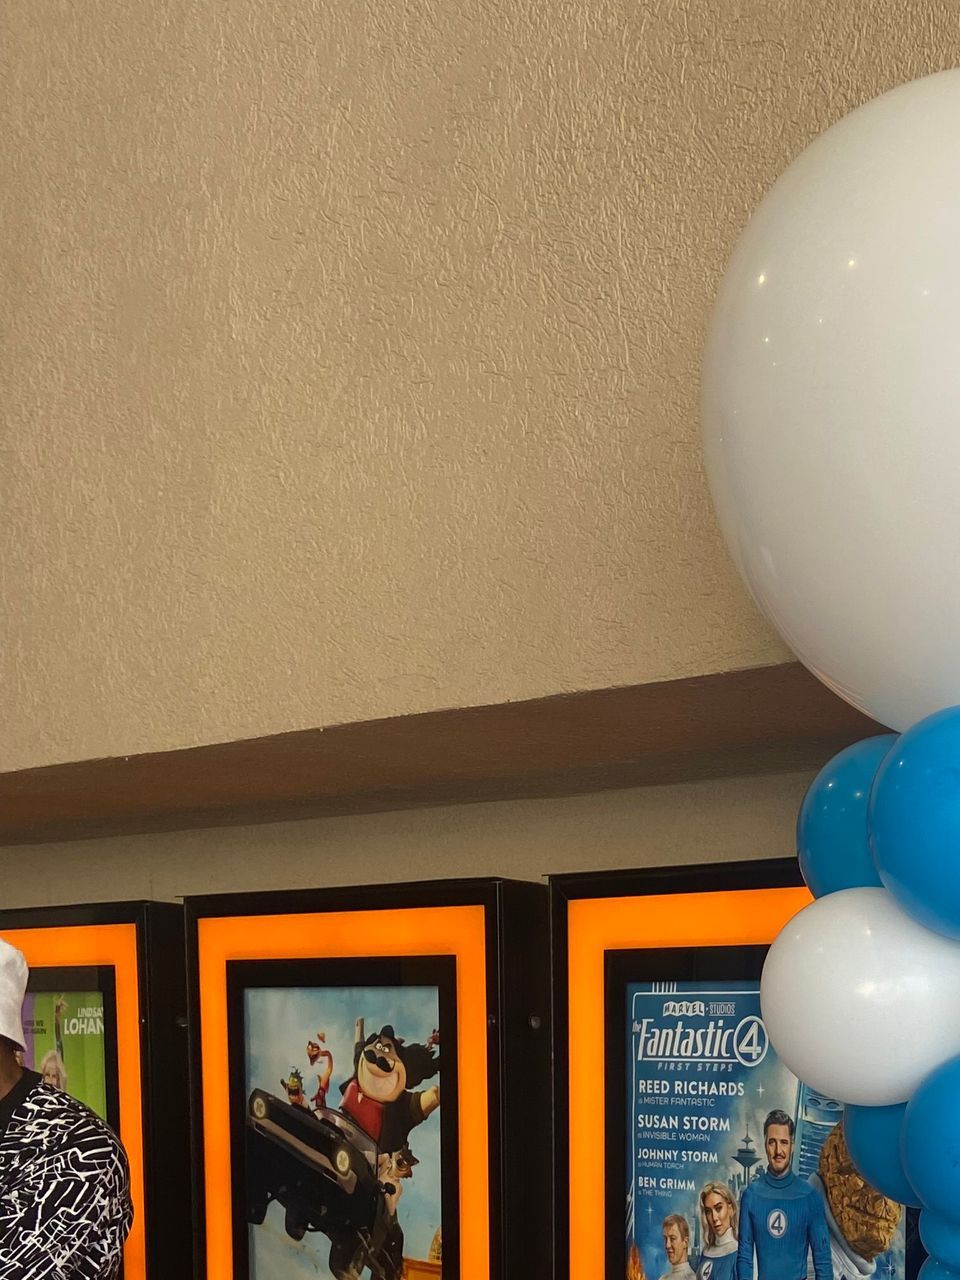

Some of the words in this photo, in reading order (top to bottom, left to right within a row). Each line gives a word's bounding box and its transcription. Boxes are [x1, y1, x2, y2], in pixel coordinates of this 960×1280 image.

[663, 1002, 704, 1015] MARVEL
[709, 1003, 735, 1015] STUDIOS
[64, 1018, 104, 1035] LOHAN
[638, 1019, 734, 1060] Fantastic
[739, 1021, 762, 1059] 4
[657, 1062, 690, 1072] FIRST
[697, 1063, 733, 1072] STEPS
[639, 1080, 670, 1094] REED
[674, 1080, 745, 1097] RICHARDS
[643, 1097, 669, 1105] MISTER
[671, 1097, 716, 1107] FANTASTIC
[637, 1114, 679, 1129] SUSAN
[683, 1116, 731, 1132] STORM
[642, 1131, 677, 1141] INVISIBLE
[678, 1132, 711, 1142] WOMAN
[637, 1148, 679, 1160] JOHNNY
[681, 1150, 718, 1163] STORM
[638, 1176, 657, 1188] BEN
[659, 1178, 696, 1191] GRIMM
